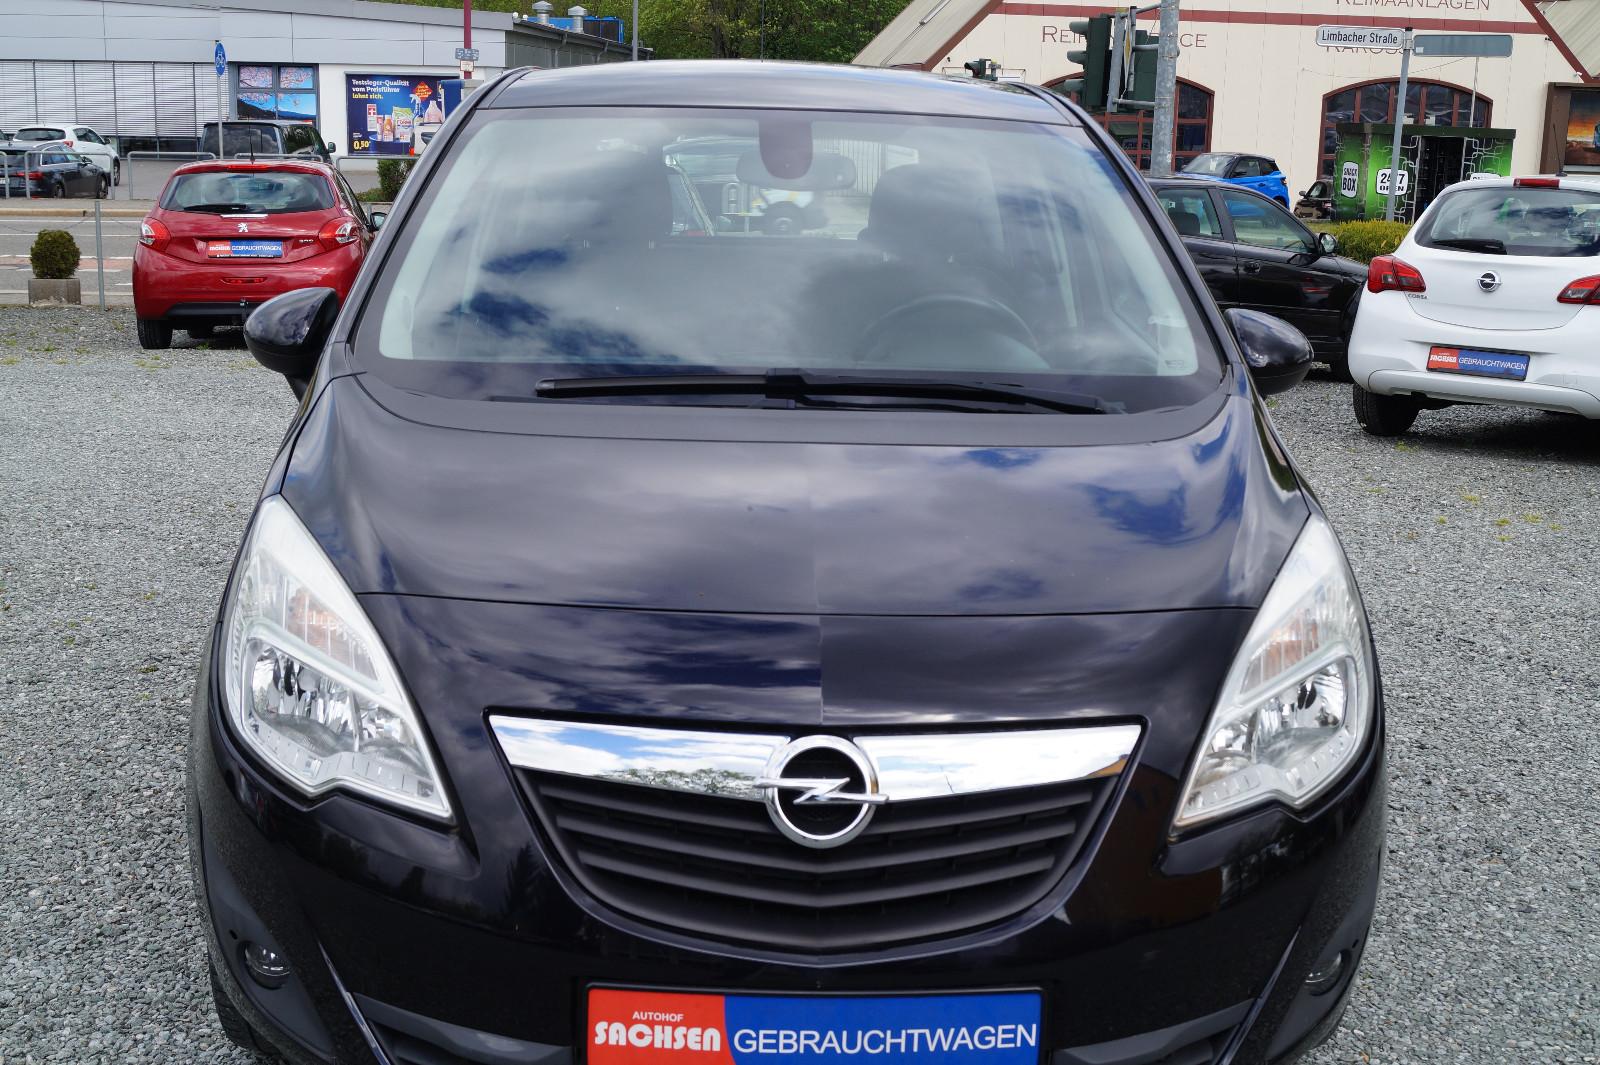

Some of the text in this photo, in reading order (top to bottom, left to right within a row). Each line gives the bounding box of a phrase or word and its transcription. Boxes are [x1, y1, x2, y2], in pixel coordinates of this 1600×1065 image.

[1322, 30, 1398, 44] Limbacher Straße
[1342, 177, 1356, 191] BOX
[1458, 357, 1527, 370] GEBRAUCHTWAGEN
[632, 1011, 684, 1022] AUTOHOF
[595, 1021, 1037, 1054] SACHSEN GEBRAUCHTWAGEN
